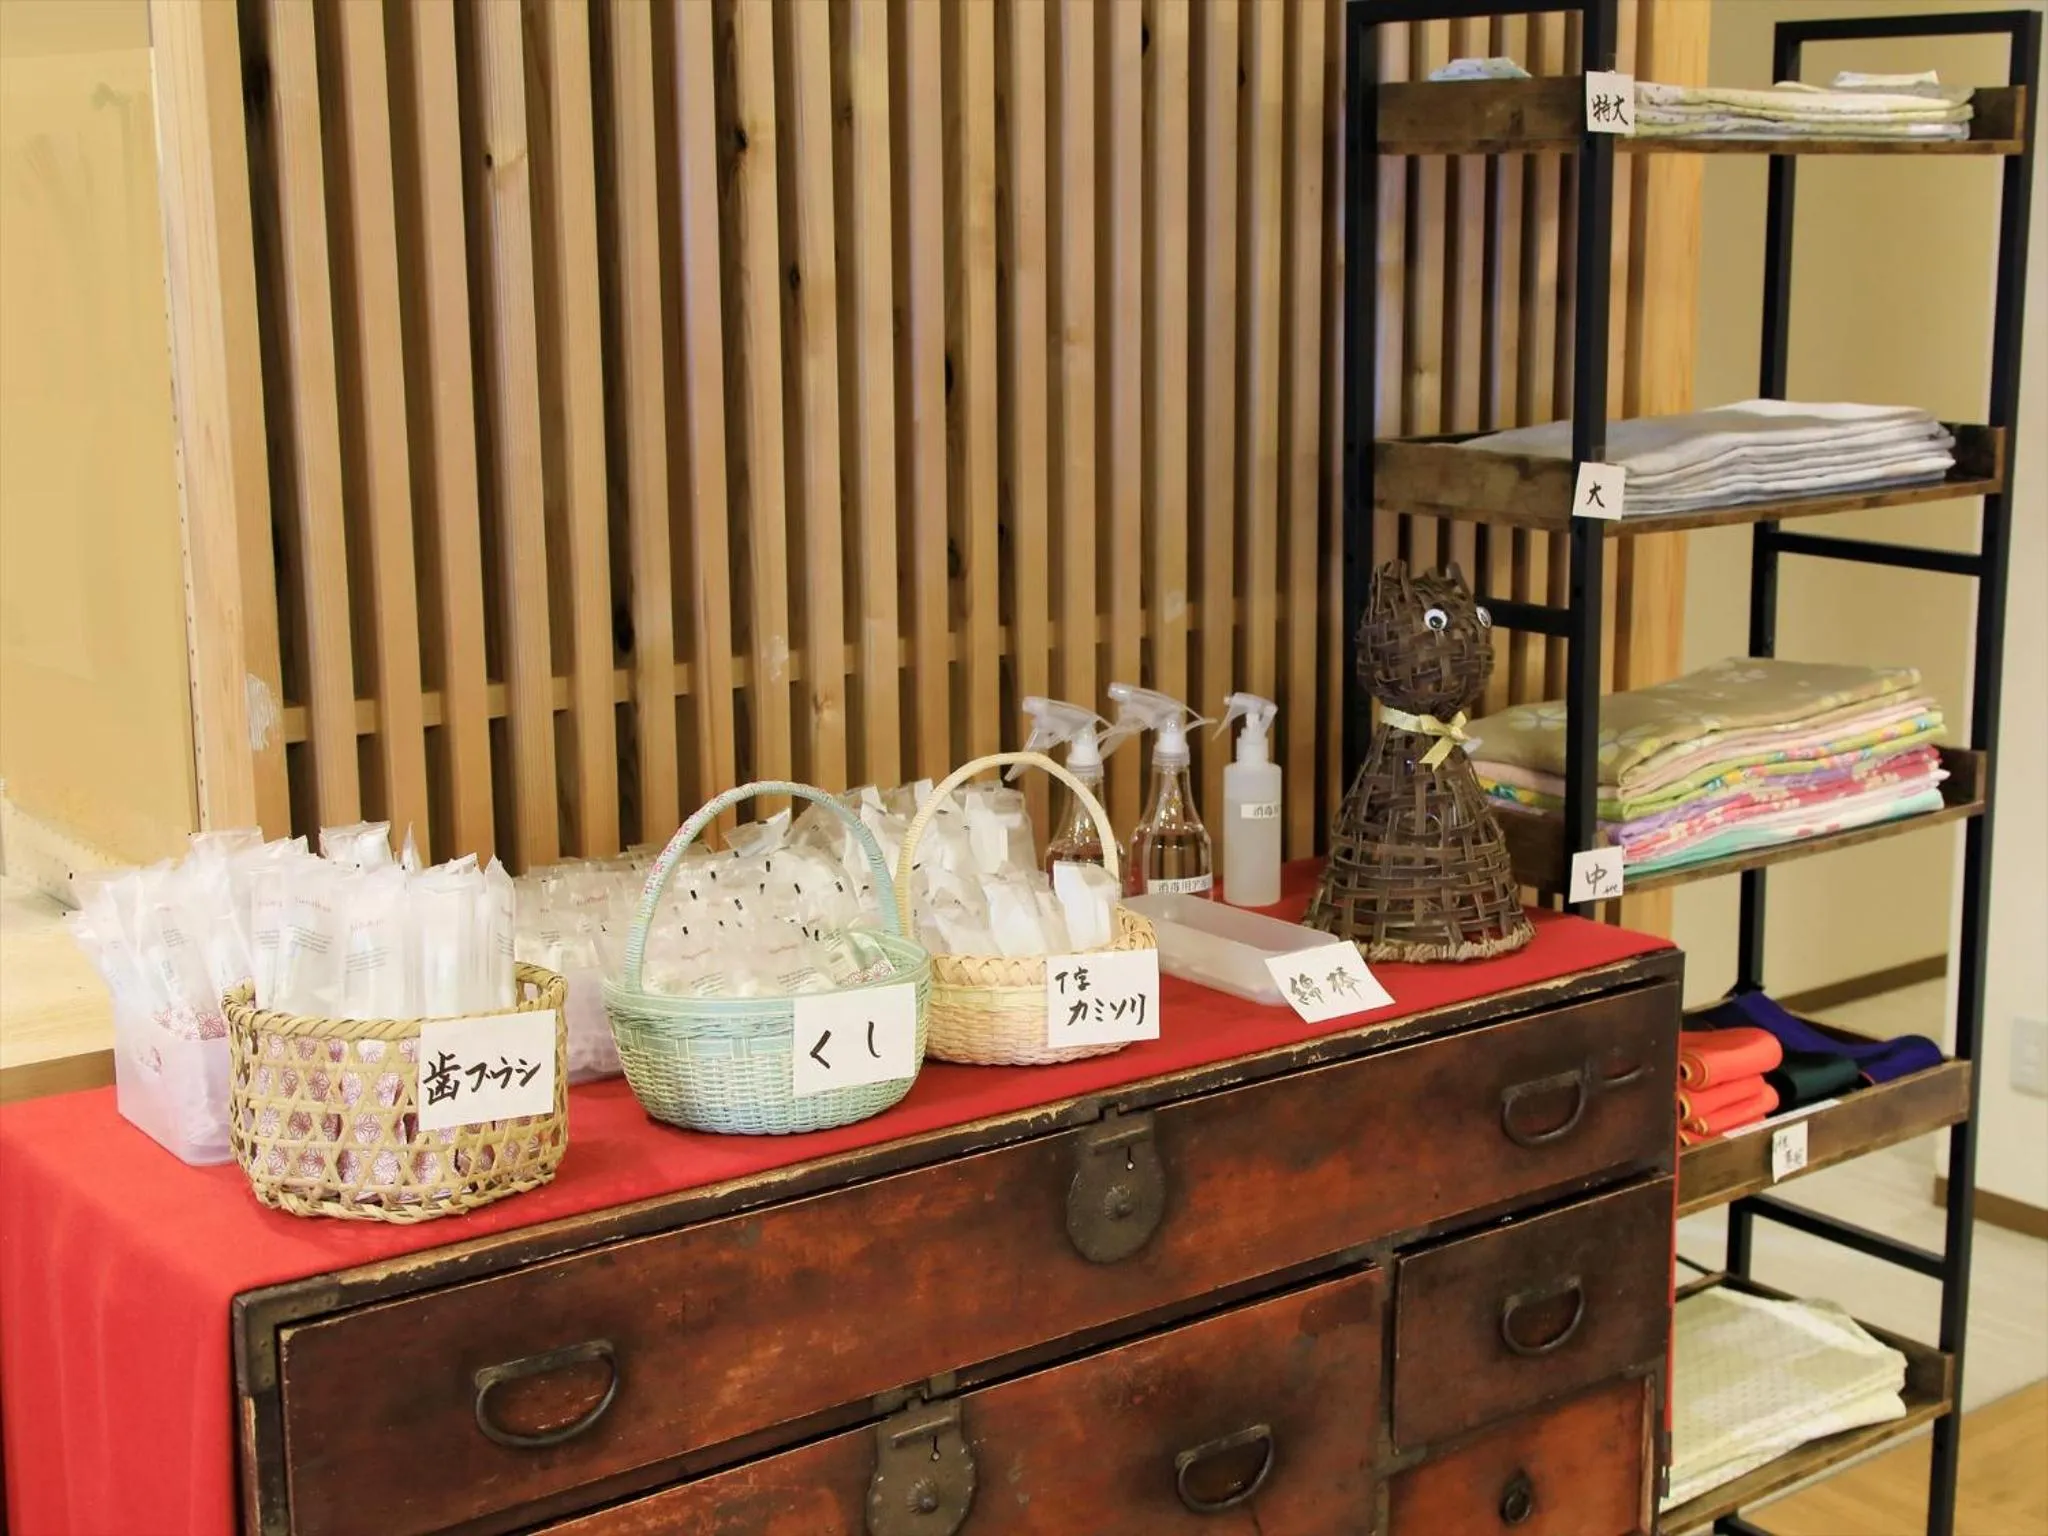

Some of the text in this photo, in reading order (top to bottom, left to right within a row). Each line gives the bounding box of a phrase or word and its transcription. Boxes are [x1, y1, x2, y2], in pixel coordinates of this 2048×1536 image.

[1591, 94, 1629, 126] 特大
[1586, 480, 1605, 508] 大
[1585, 863, 1608, 896] 中
[1067, 993, 1146, 1026] カミソリ
[809, 1020, 881, 1069] くし
[423, 1050, 541, 1106] 歯ブラシ
